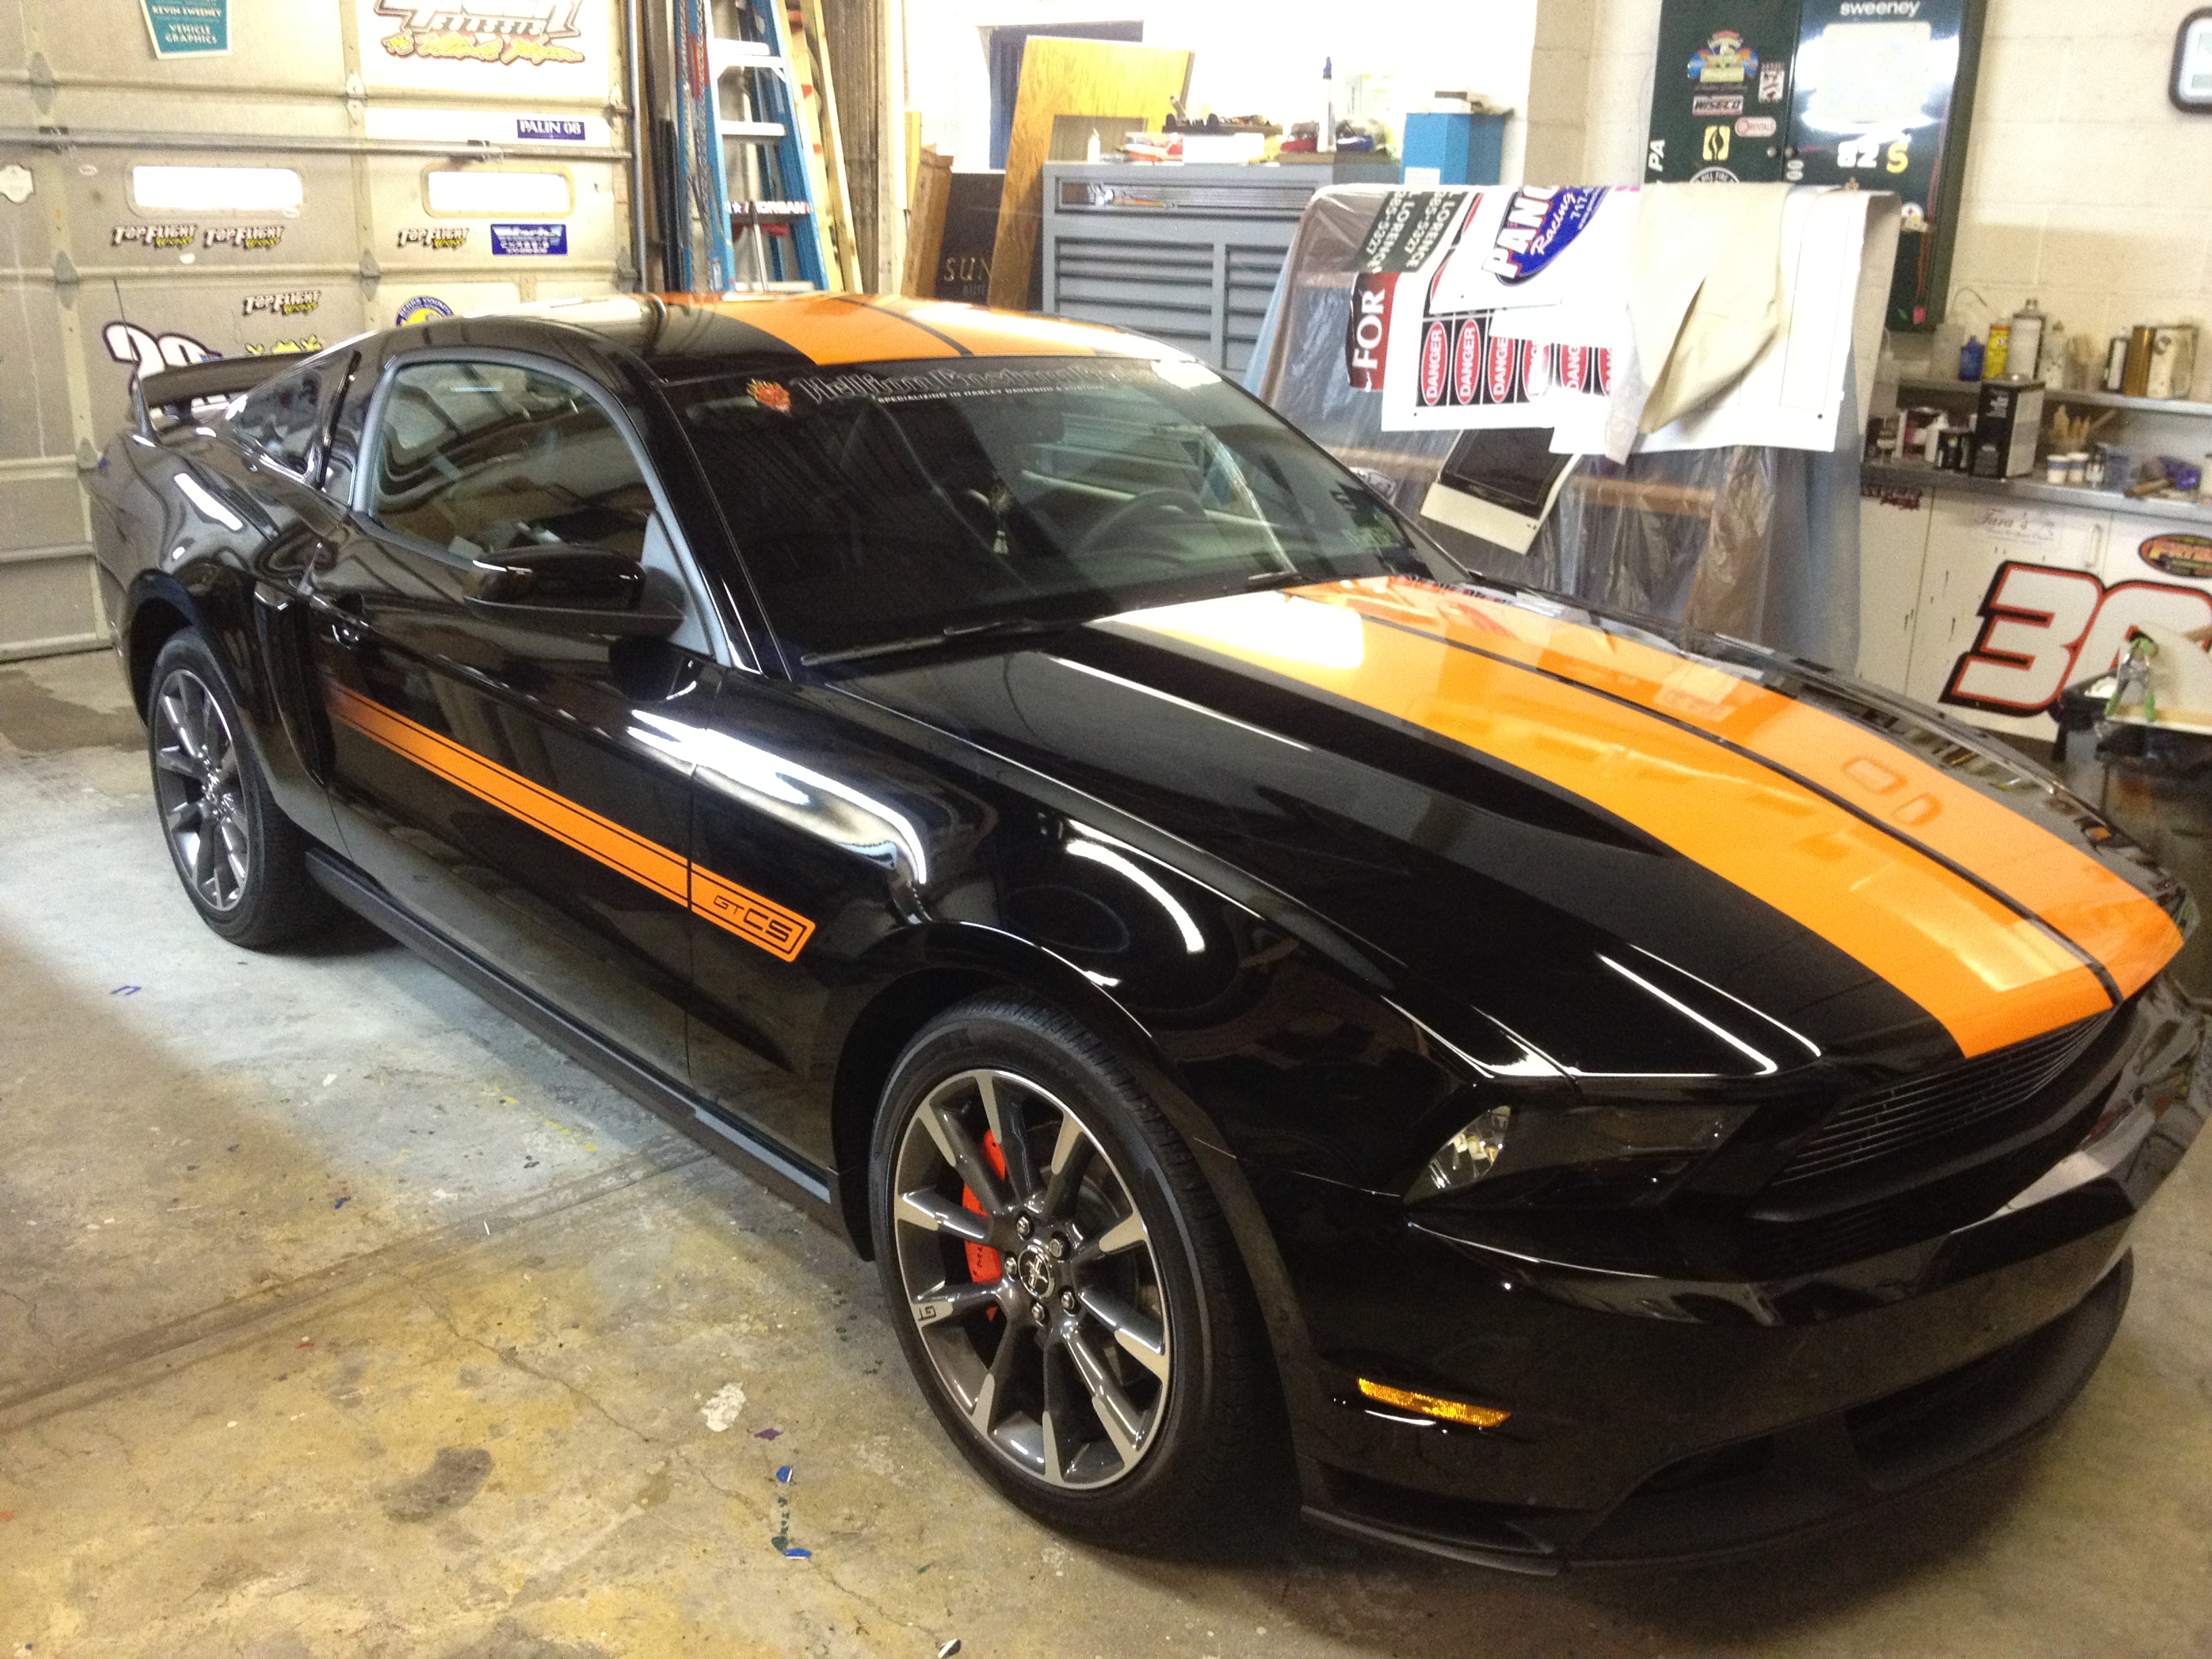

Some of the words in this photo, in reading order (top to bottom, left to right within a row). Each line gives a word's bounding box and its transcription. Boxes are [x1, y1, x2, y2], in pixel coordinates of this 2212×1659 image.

[1840, 0, 1921, 18] sweeney
[520, 121, 561, 134] PALIN
[1647, 138, 1666, 172] PA
[1530, 192, 1576, 255] Racing
[1352, 288, 1386, 369] FOR
[1426, 328, 1442, 398] DANGER
[1460, 326, 1475, 396] DANGER
[1493, 337, 1509, 395] DANGE
[1567, 346, 1581, 389] DANG
